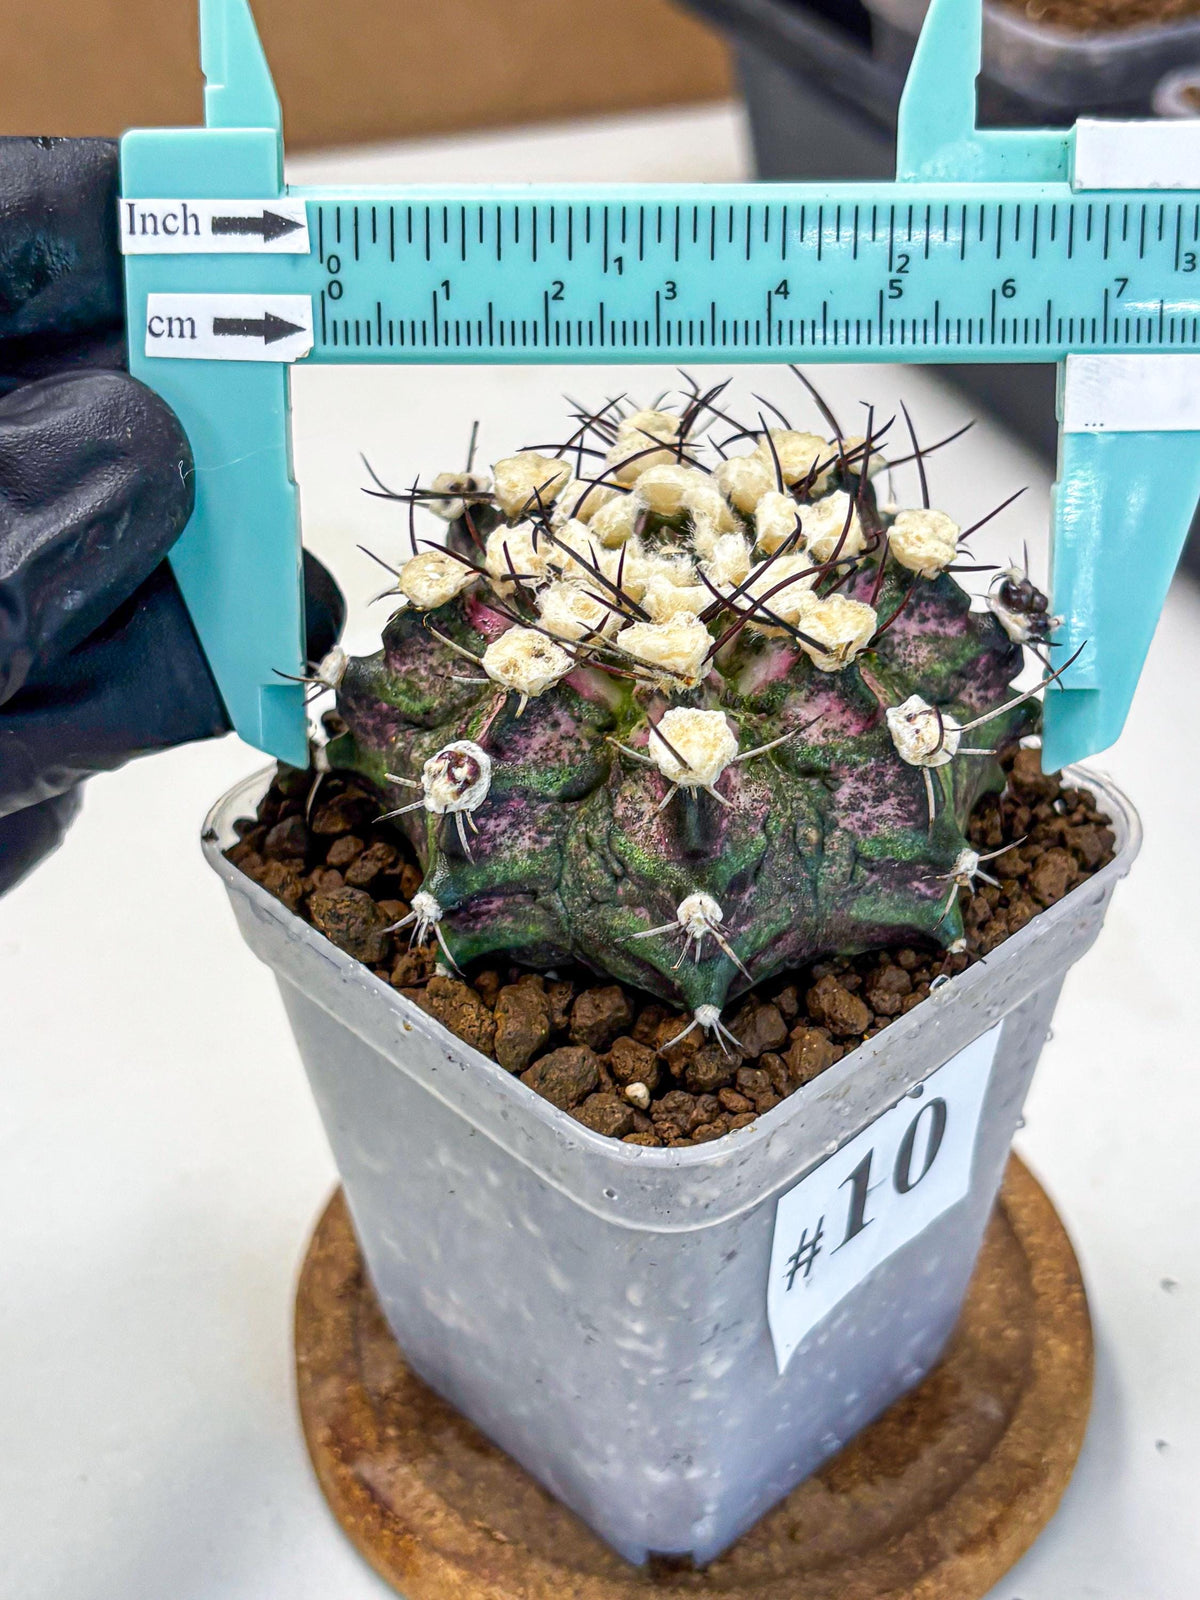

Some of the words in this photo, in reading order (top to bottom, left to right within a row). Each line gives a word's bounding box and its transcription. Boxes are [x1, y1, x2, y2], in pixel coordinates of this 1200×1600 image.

[126, 202, 201, 236] Inch
[326, 254, 341, 275] 0
[613, 256, 623, 276] 1
[895, 253, 910, 274] 2
[1182, 252, 1197, 273] 3
[327, 279, 344, 301] 0
[440, 279, 450, 301] 1
[551, 280, 565, 301] 2
[664, 280, 678, 301] 3
[774, 279, 790, 300] 4
[888, 278, 904, 300] 5
[1001, 278, 1017, 299] 6
[1114, 277, 1129, 299] 7
[147, 314, 197, 340] cm
[783, 1097, 947, 1291] #10
